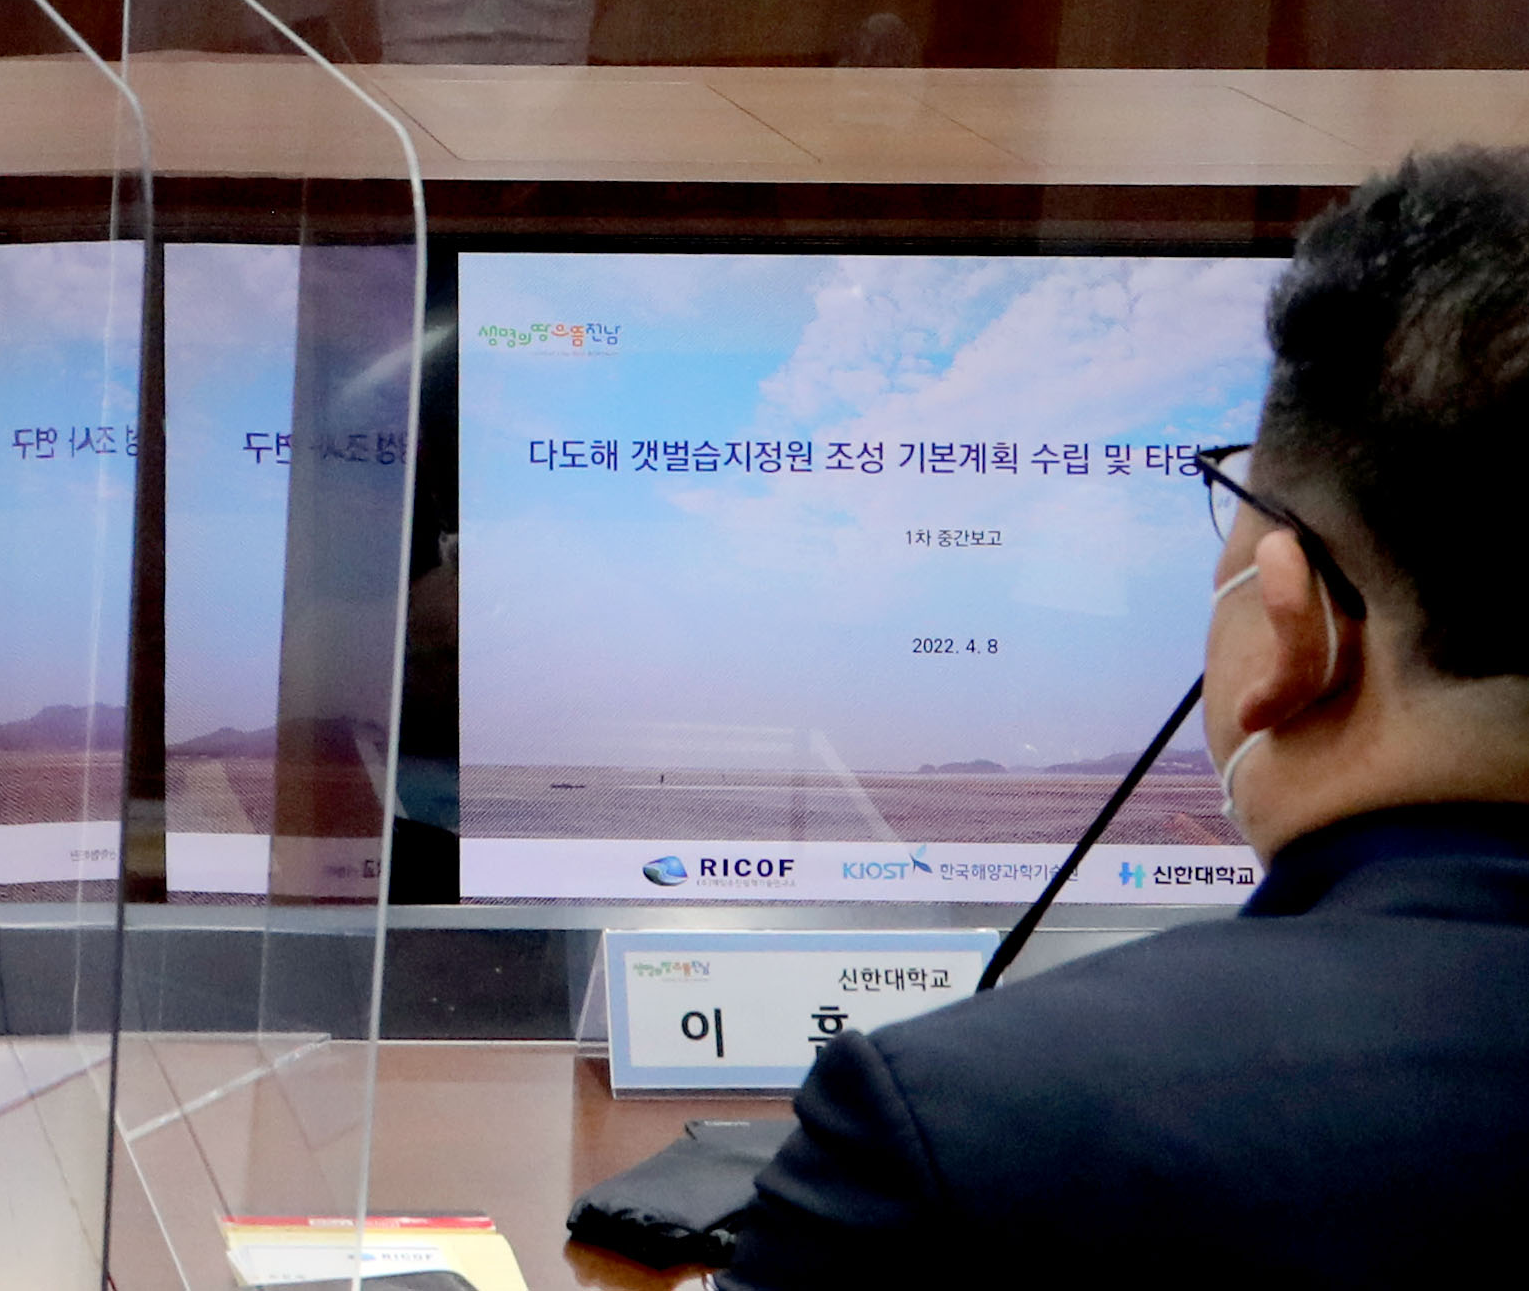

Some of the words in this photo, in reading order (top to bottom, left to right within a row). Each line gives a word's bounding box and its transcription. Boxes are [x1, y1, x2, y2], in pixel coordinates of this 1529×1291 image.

[529, 439, 618, 472] 다도해
[631, 439, 813, 473] 갯벌습지정원
[825, 441, 884, 474] 조성
[899, 441, 1018, 475] 기본계획
[1030, 442, 1089, 475] 수립
[1104, 443, 1131, 476] 및
[906, 529, 932, 547] 1차
[938, 529, 1003, 548] 중간보고
[912, 637, 959, 654] 2022.
[966, 638, 981, 655] 4.
[987, 638, 998, 655] 8
[700, 858, 795, 877] RICOF
[1153, 865, 1256, 886] 신한대학교
[838, 967, 952, 992] 신한대학교
